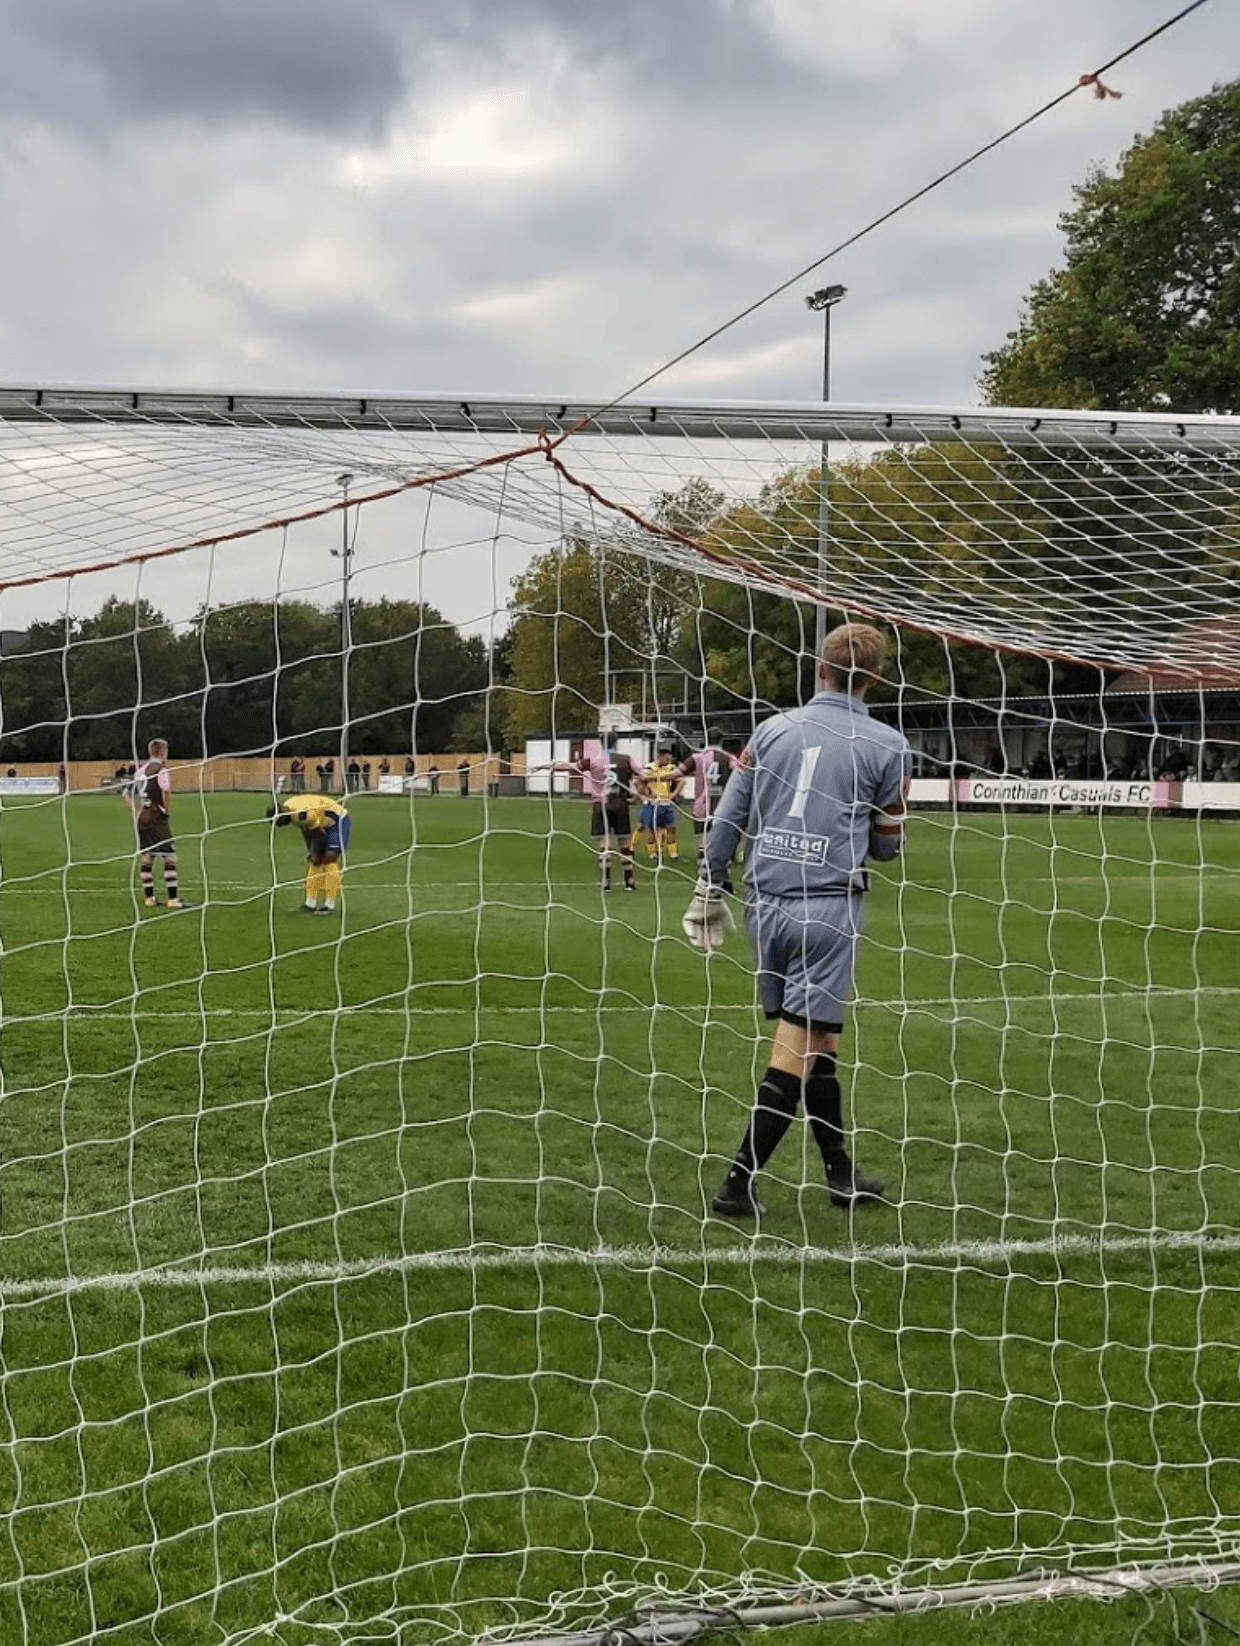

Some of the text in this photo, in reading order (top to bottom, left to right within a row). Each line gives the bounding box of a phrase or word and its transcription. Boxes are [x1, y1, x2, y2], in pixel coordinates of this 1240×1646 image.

[707, 762, 721, 784] 4
[788, 746, 822, 818] 1
[1126, 785, 1151, 801] FC
[764, 833, 822, 852] united
